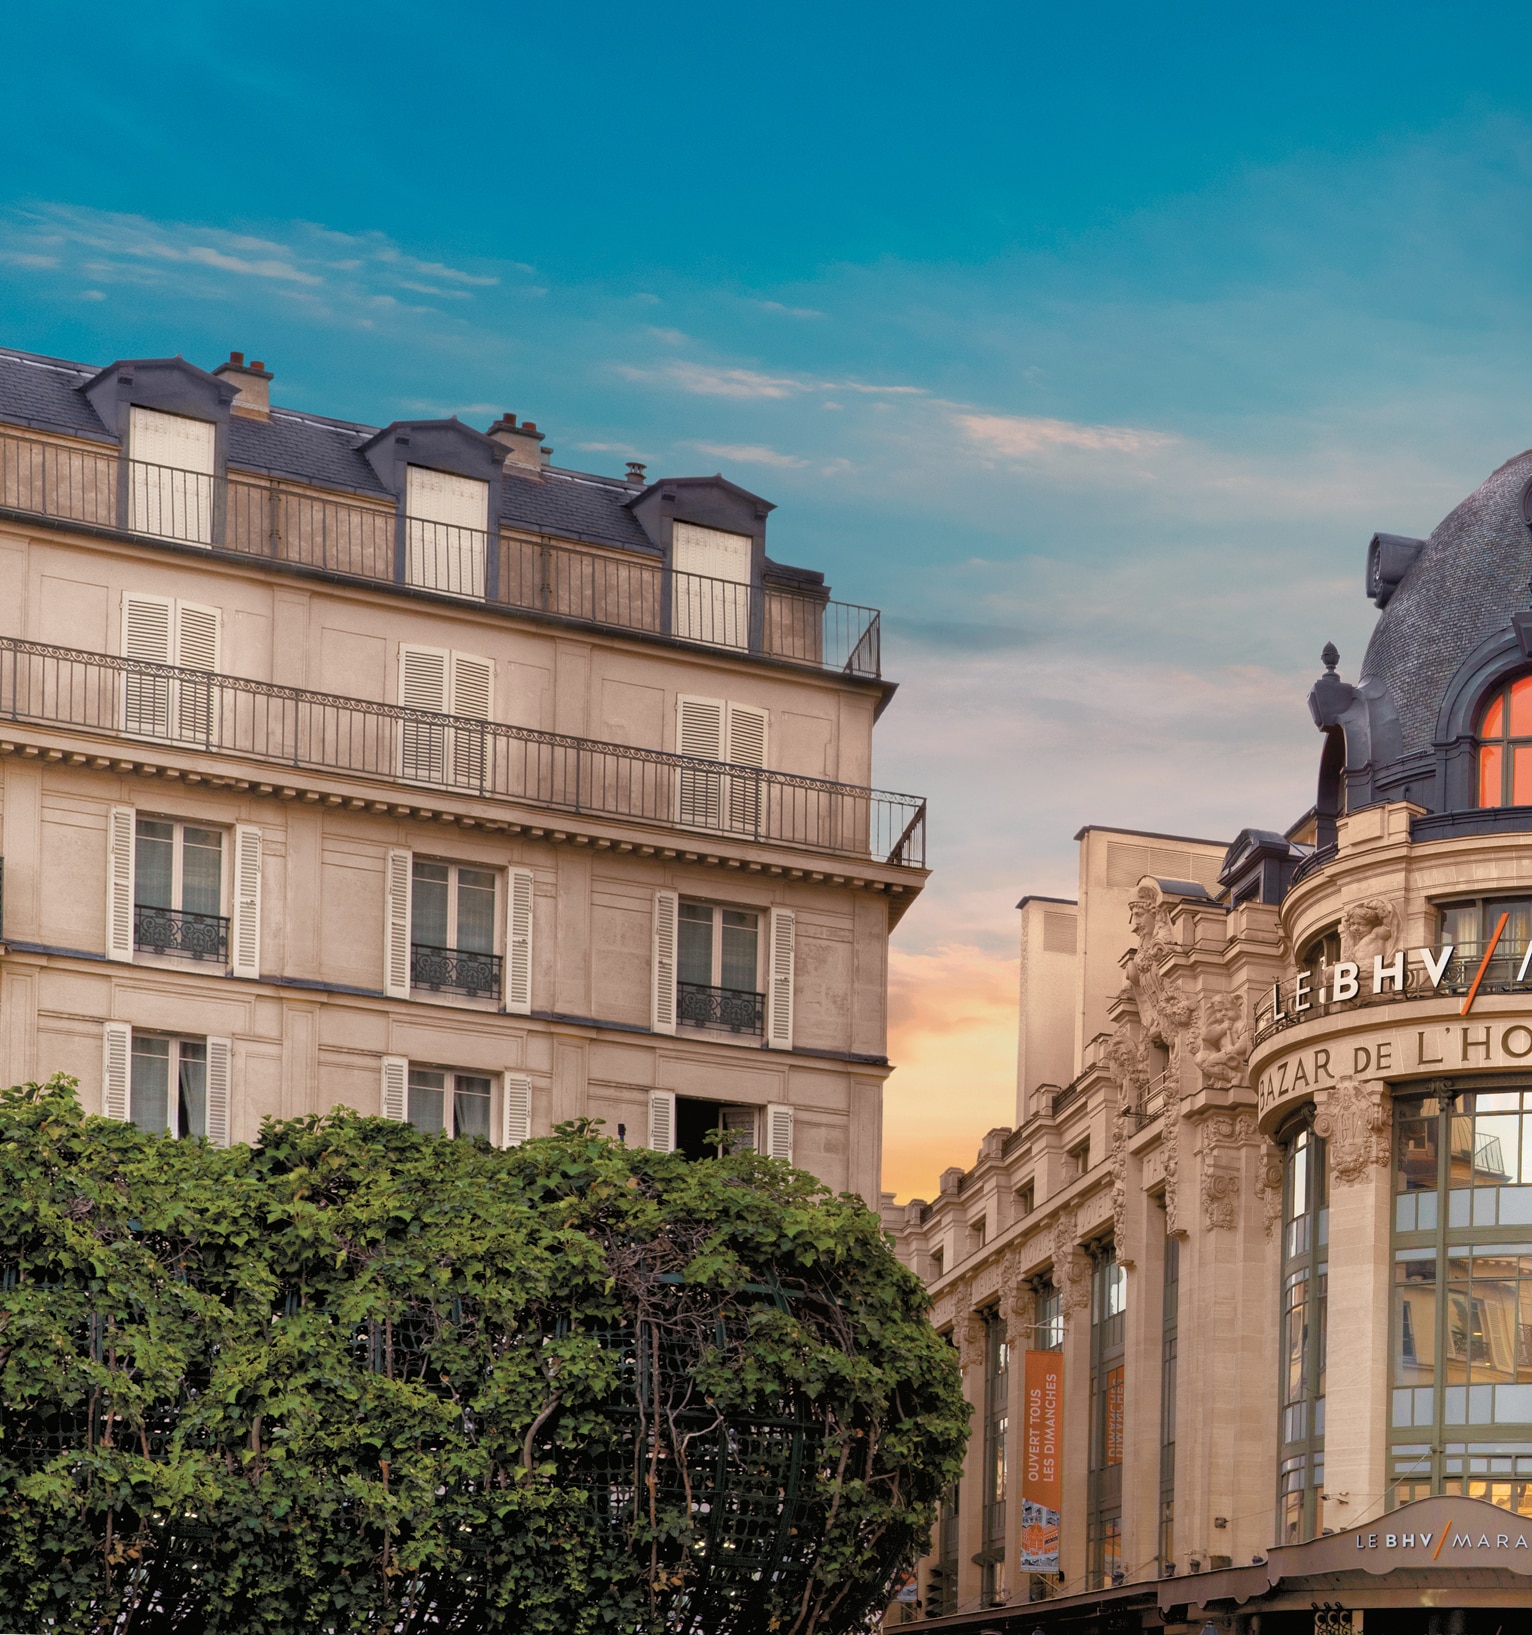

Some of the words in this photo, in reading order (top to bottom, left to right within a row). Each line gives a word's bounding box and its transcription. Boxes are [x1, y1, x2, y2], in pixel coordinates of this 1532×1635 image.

[1272, 970, 1313, 1021] LE
[1333, 946, 1455, 1001] BHV
[1258, 1048, 1335, 1113] BAZAR
[1353, 1042, 1392, 1075] DE
[1030, 1389, 1041, 1424] TOUS
[1044, 1374, 1057, 1454] DIMANCHES
[1028, 1428, 1040, 1481] OUVERT
[1043, 1458, 1054, 1482] LES
[1356, 1534, 1378, 1549] LE
[1386, 1533, 1433, 1548] BHV
